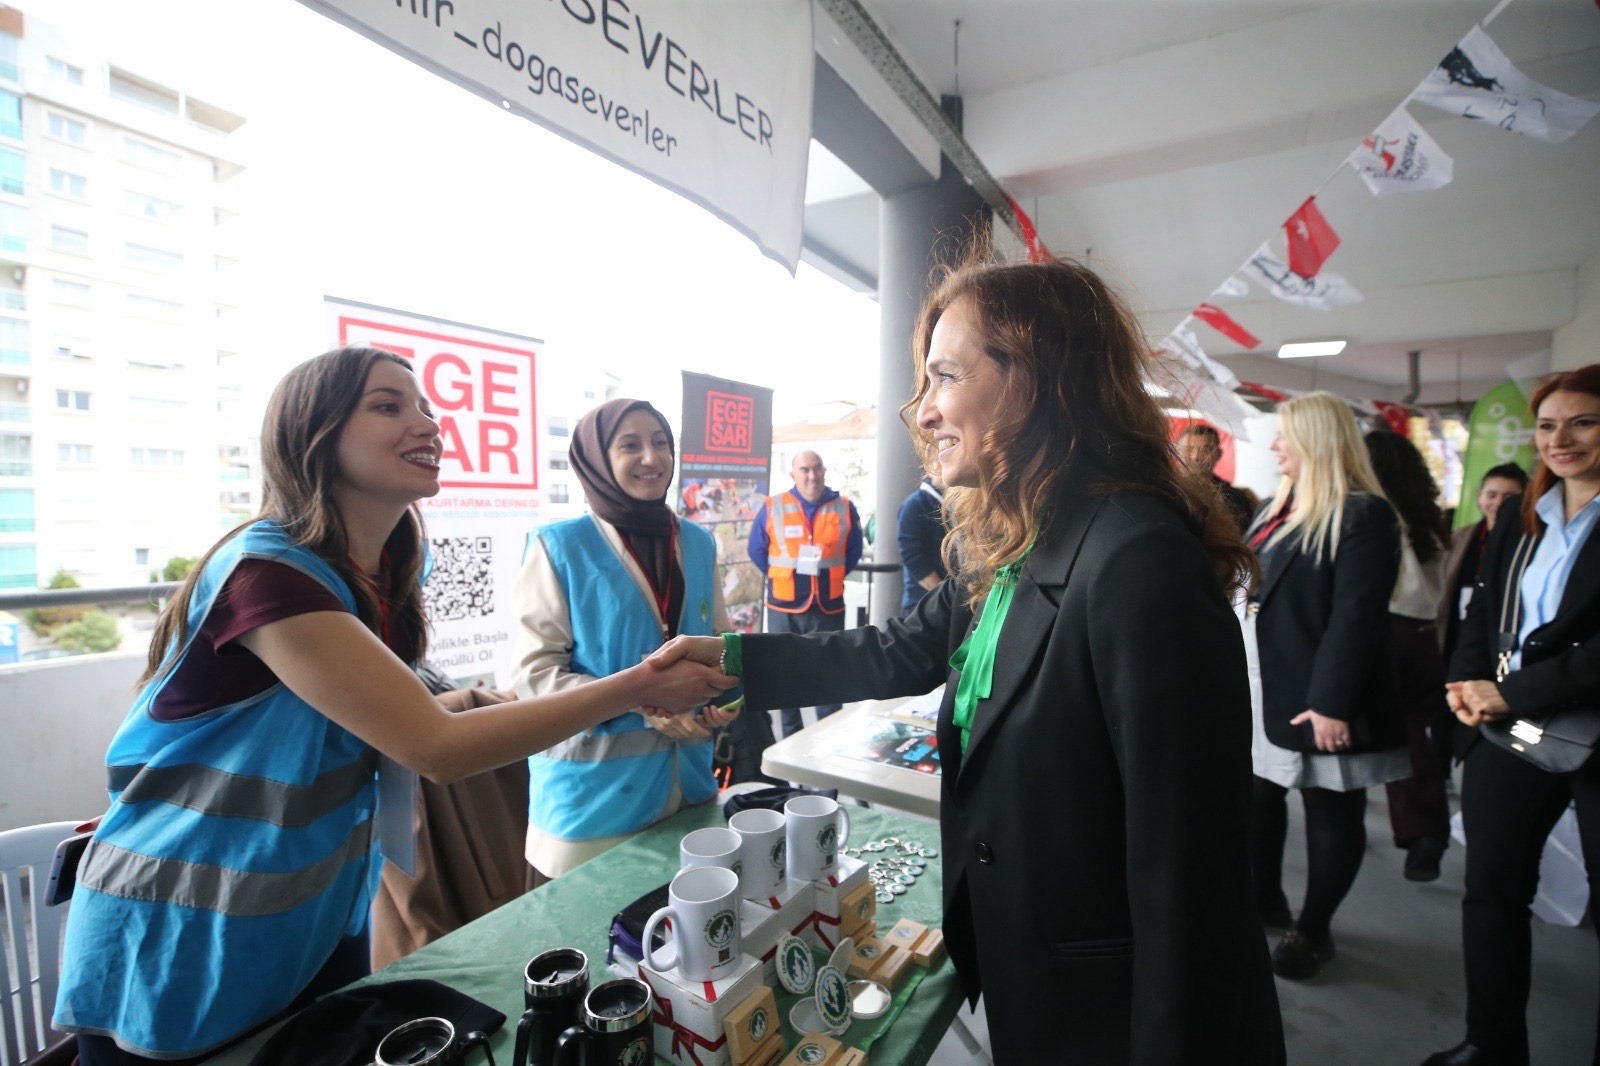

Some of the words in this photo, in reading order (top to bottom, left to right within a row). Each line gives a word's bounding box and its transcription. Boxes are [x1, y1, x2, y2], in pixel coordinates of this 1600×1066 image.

[370, 341, 520, 417] GE
[712, 398, 748, 423] EGE
[437, 416, 520, 475] AR
[711, 422, 749, 447] SAR
[426, 498, 492, 508] KURTARMA
[431, 637, 470, 653] yilikle
[473, 631, 509, 645] Başla
[431, 651, 475, 668] önüllü
[478, 649, 494, 661] Ol
